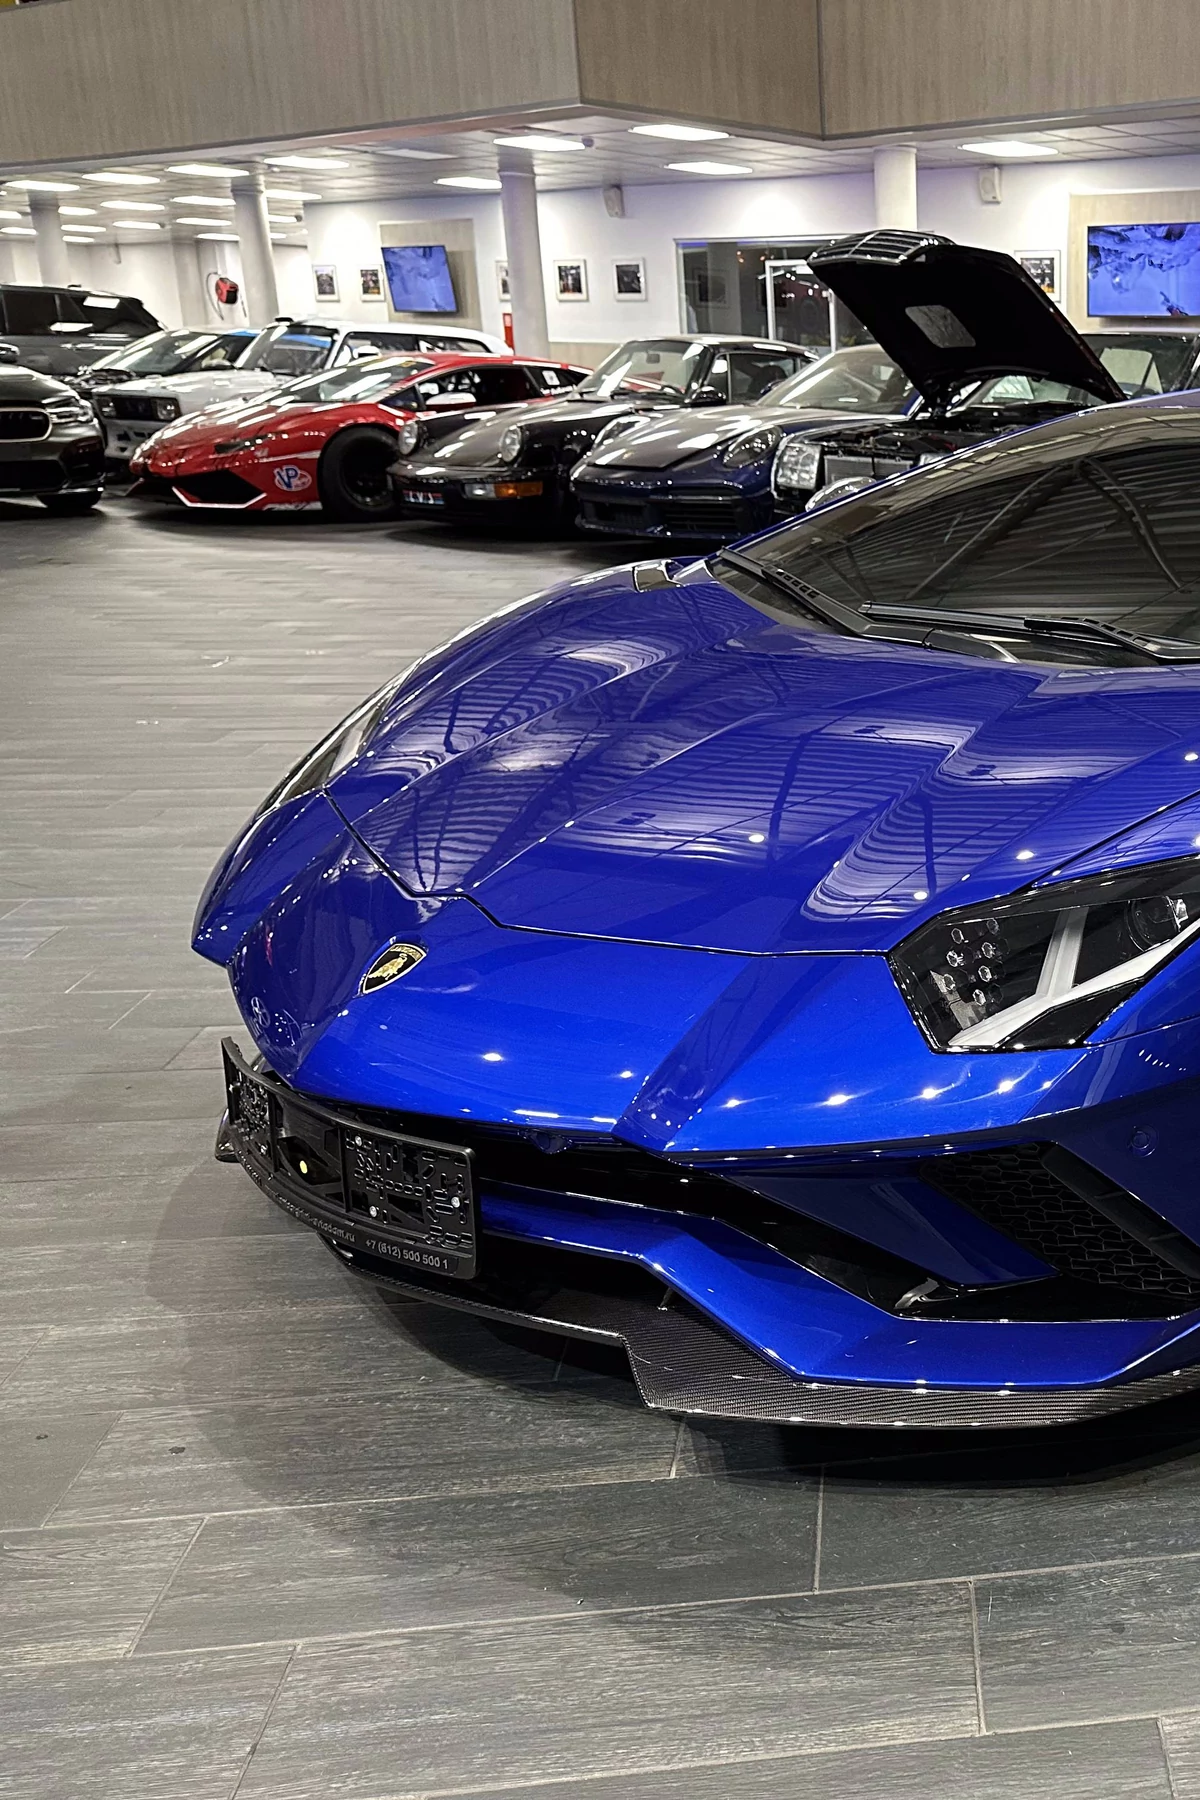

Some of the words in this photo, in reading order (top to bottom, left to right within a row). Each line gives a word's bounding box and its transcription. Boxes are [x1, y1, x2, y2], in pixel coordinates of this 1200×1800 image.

[365, 1239, 377, 1250] +7
[378, 1241, 401, 1259] (812)
[402, 1249, 421, 1263] 500
[422, 1255, 441, 1268] 500
[442, 1259, 448, 1270] 1
